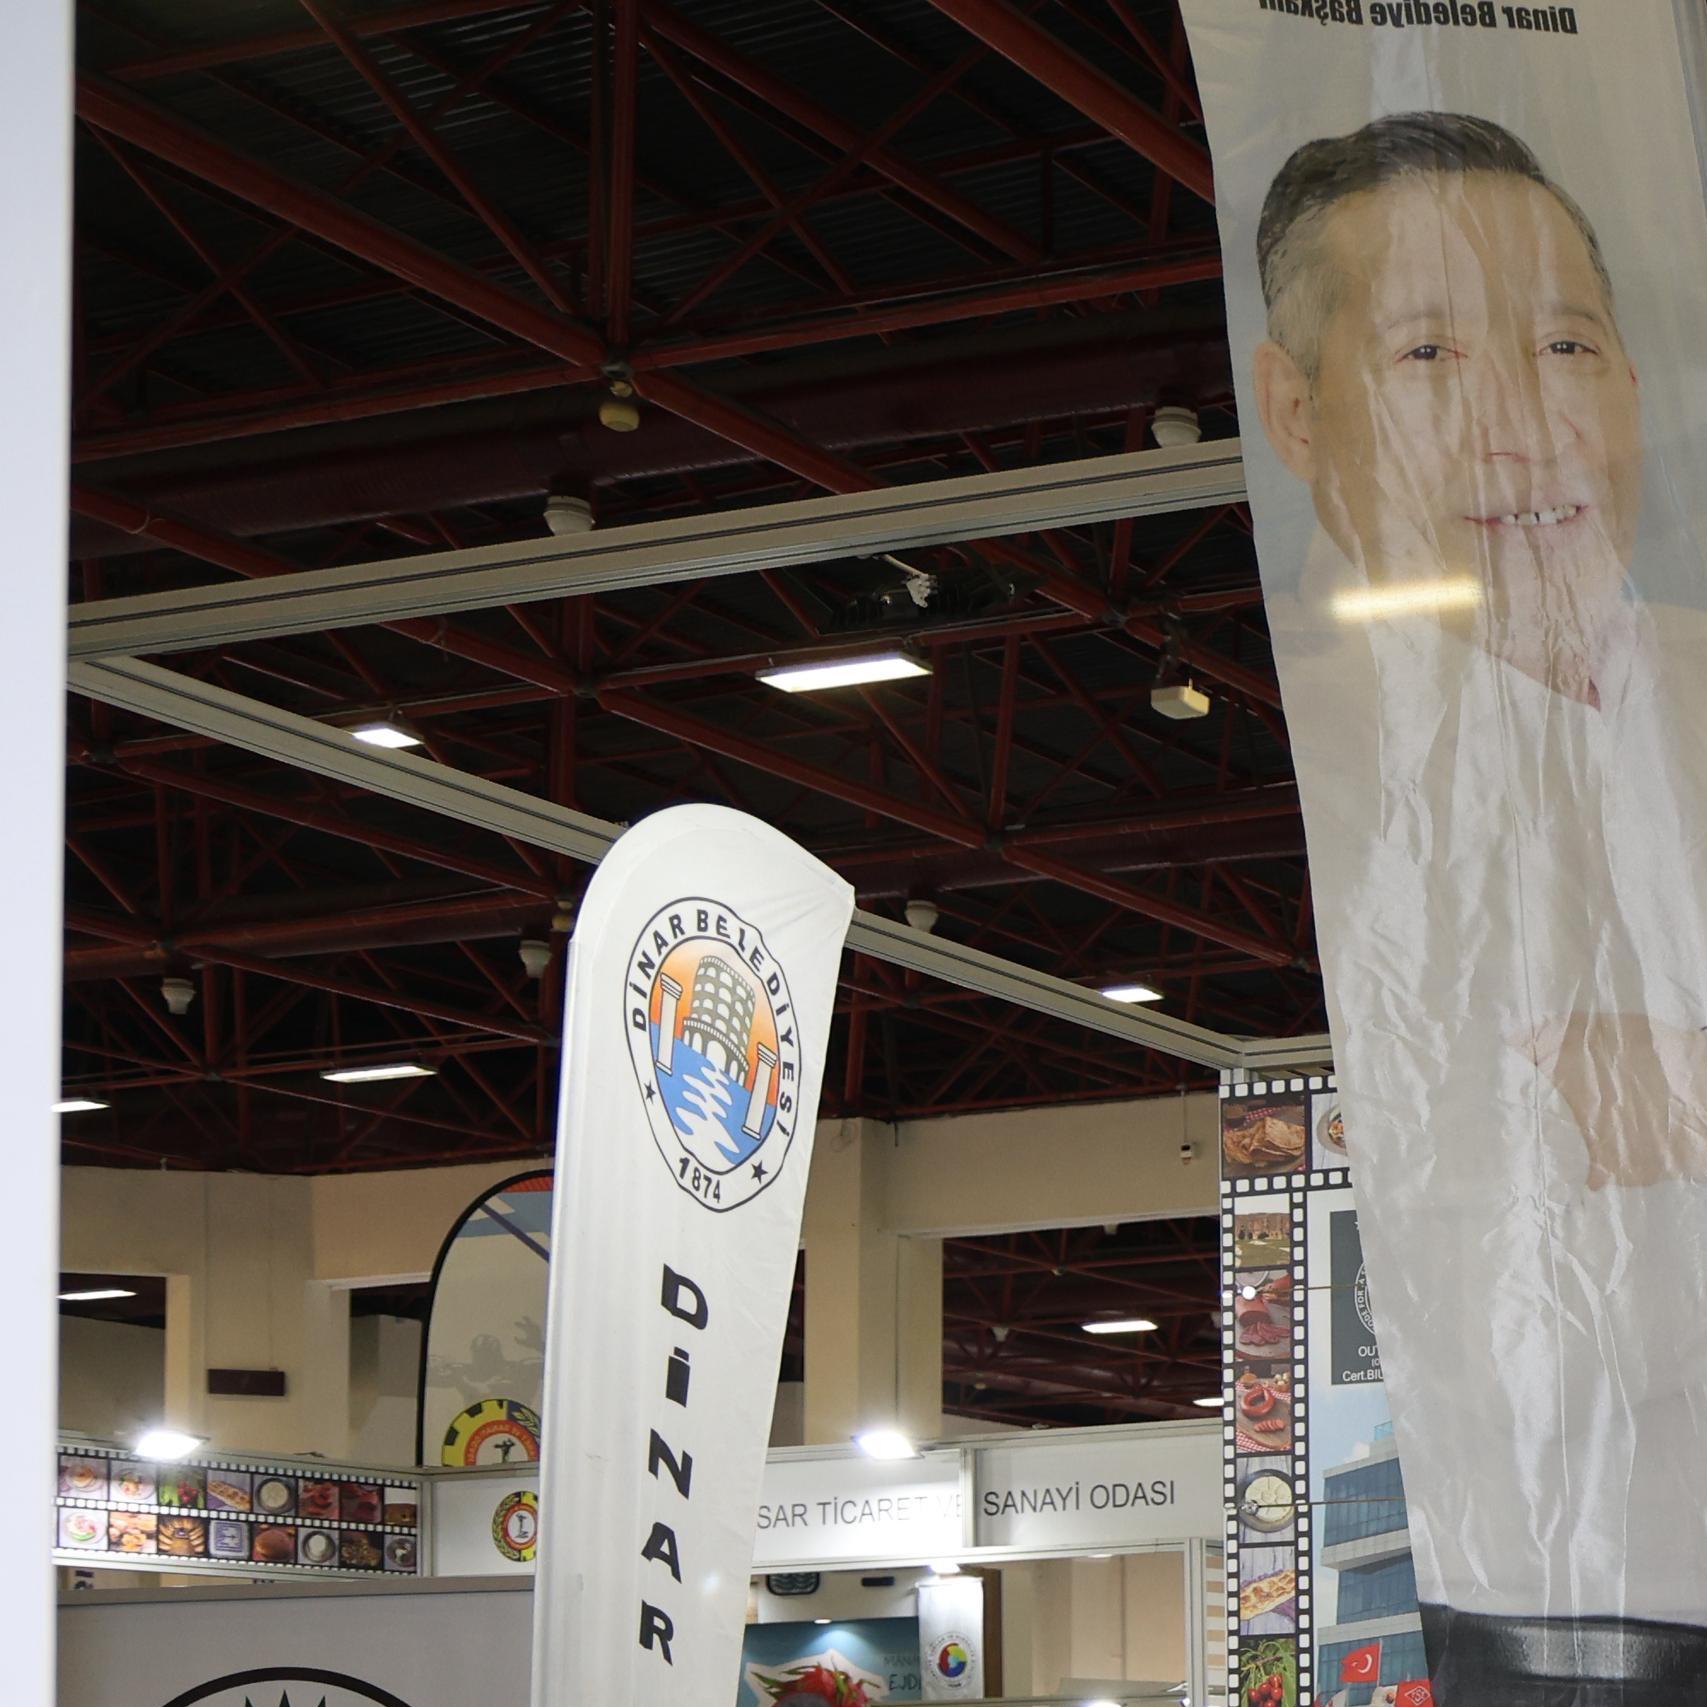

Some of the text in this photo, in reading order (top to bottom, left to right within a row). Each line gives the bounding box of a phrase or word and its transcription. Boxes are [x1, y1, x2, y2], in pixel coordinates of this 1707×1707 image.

[629, 908, 795, 1137] DİNAR BELEDİYESİ
[678, 1156, 721, 1203] 1874
[639, 1263, 709, 1666] DİNAR
[816, 1496, 929, 1526] TİCARET
[983, 1480, 1175, 1516] SANAYİ ODASI
